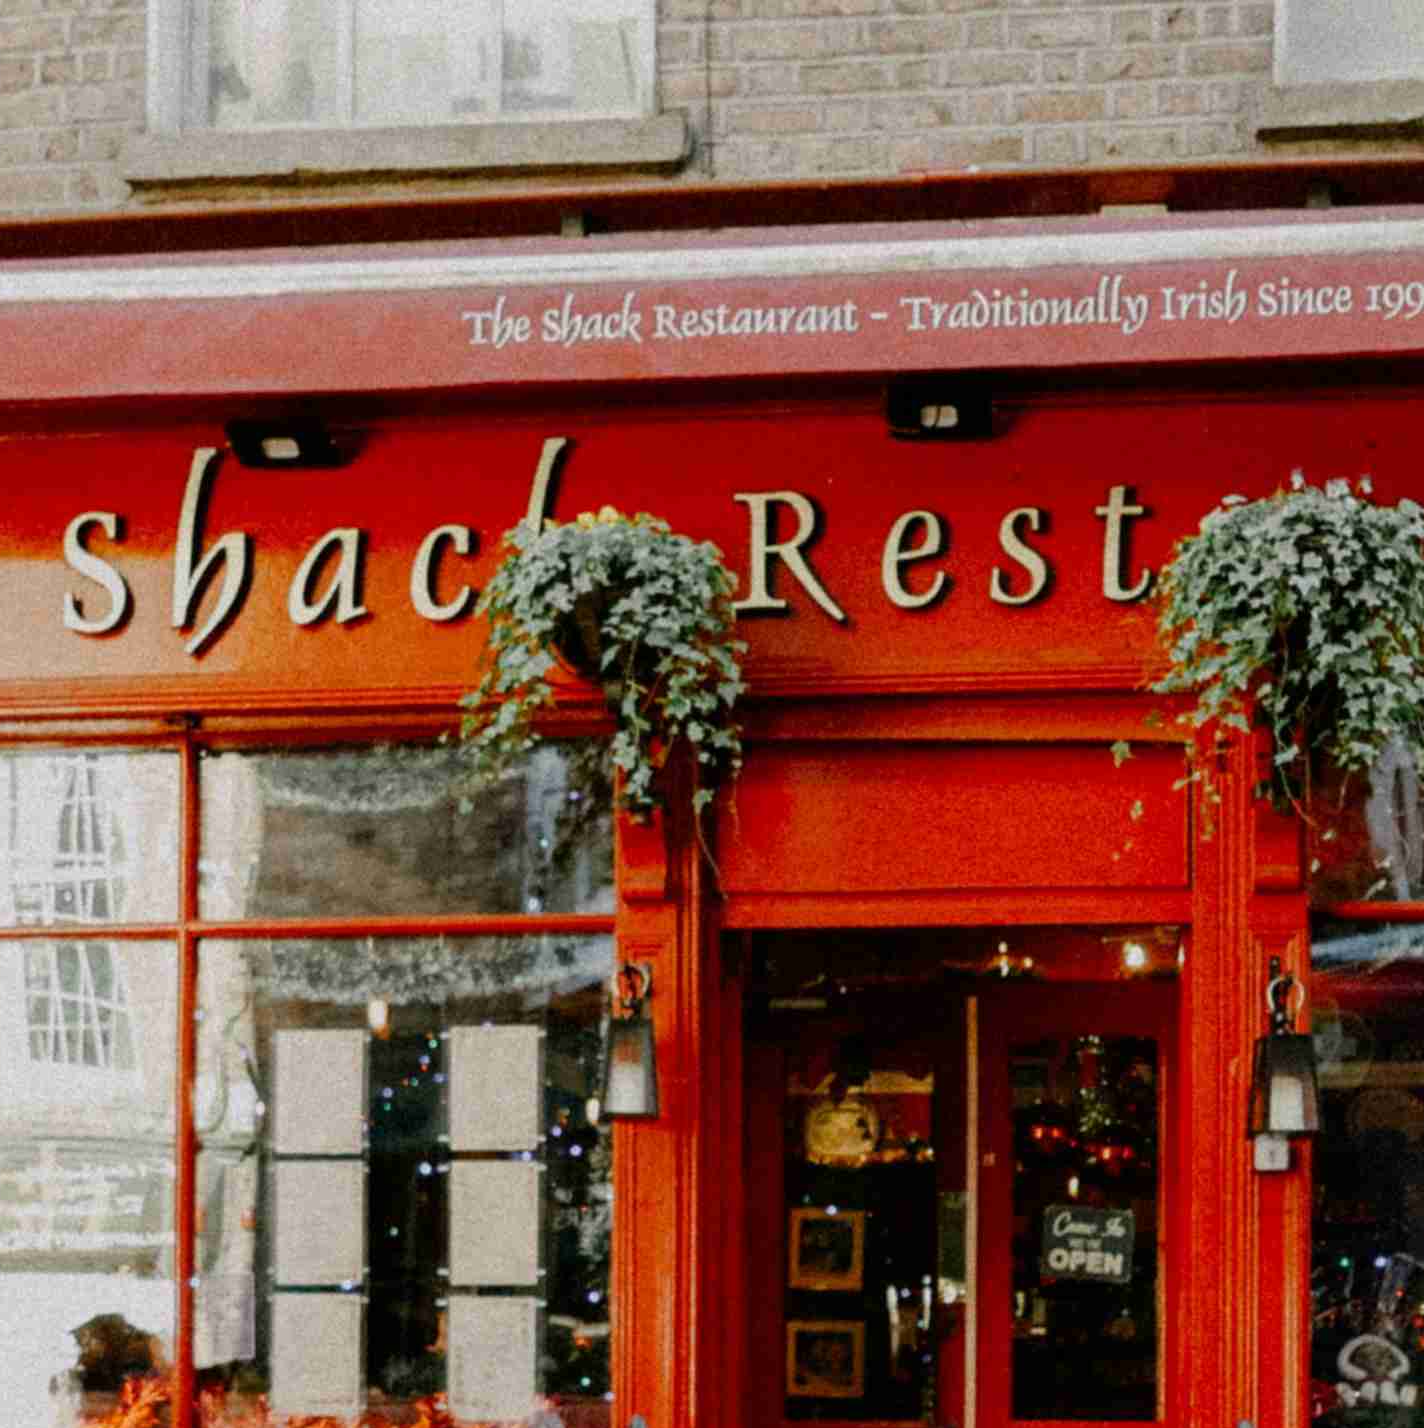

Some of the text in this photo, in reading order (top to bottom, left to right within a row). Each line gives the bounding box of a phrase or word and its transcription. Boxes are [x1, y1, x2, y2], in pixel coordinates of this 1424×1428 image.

[462, 294, 531, 349] The
[542, 290, 641, 349] Shack
[653, 299, 858, 339] Restaurant
[900, 275, 1149, 334] Traditionally
[1160, 269, 1247, 323] Irish
[1258, 281, 1352, 318] Since
[1048, 1247, 1123, 1275] OPEN
